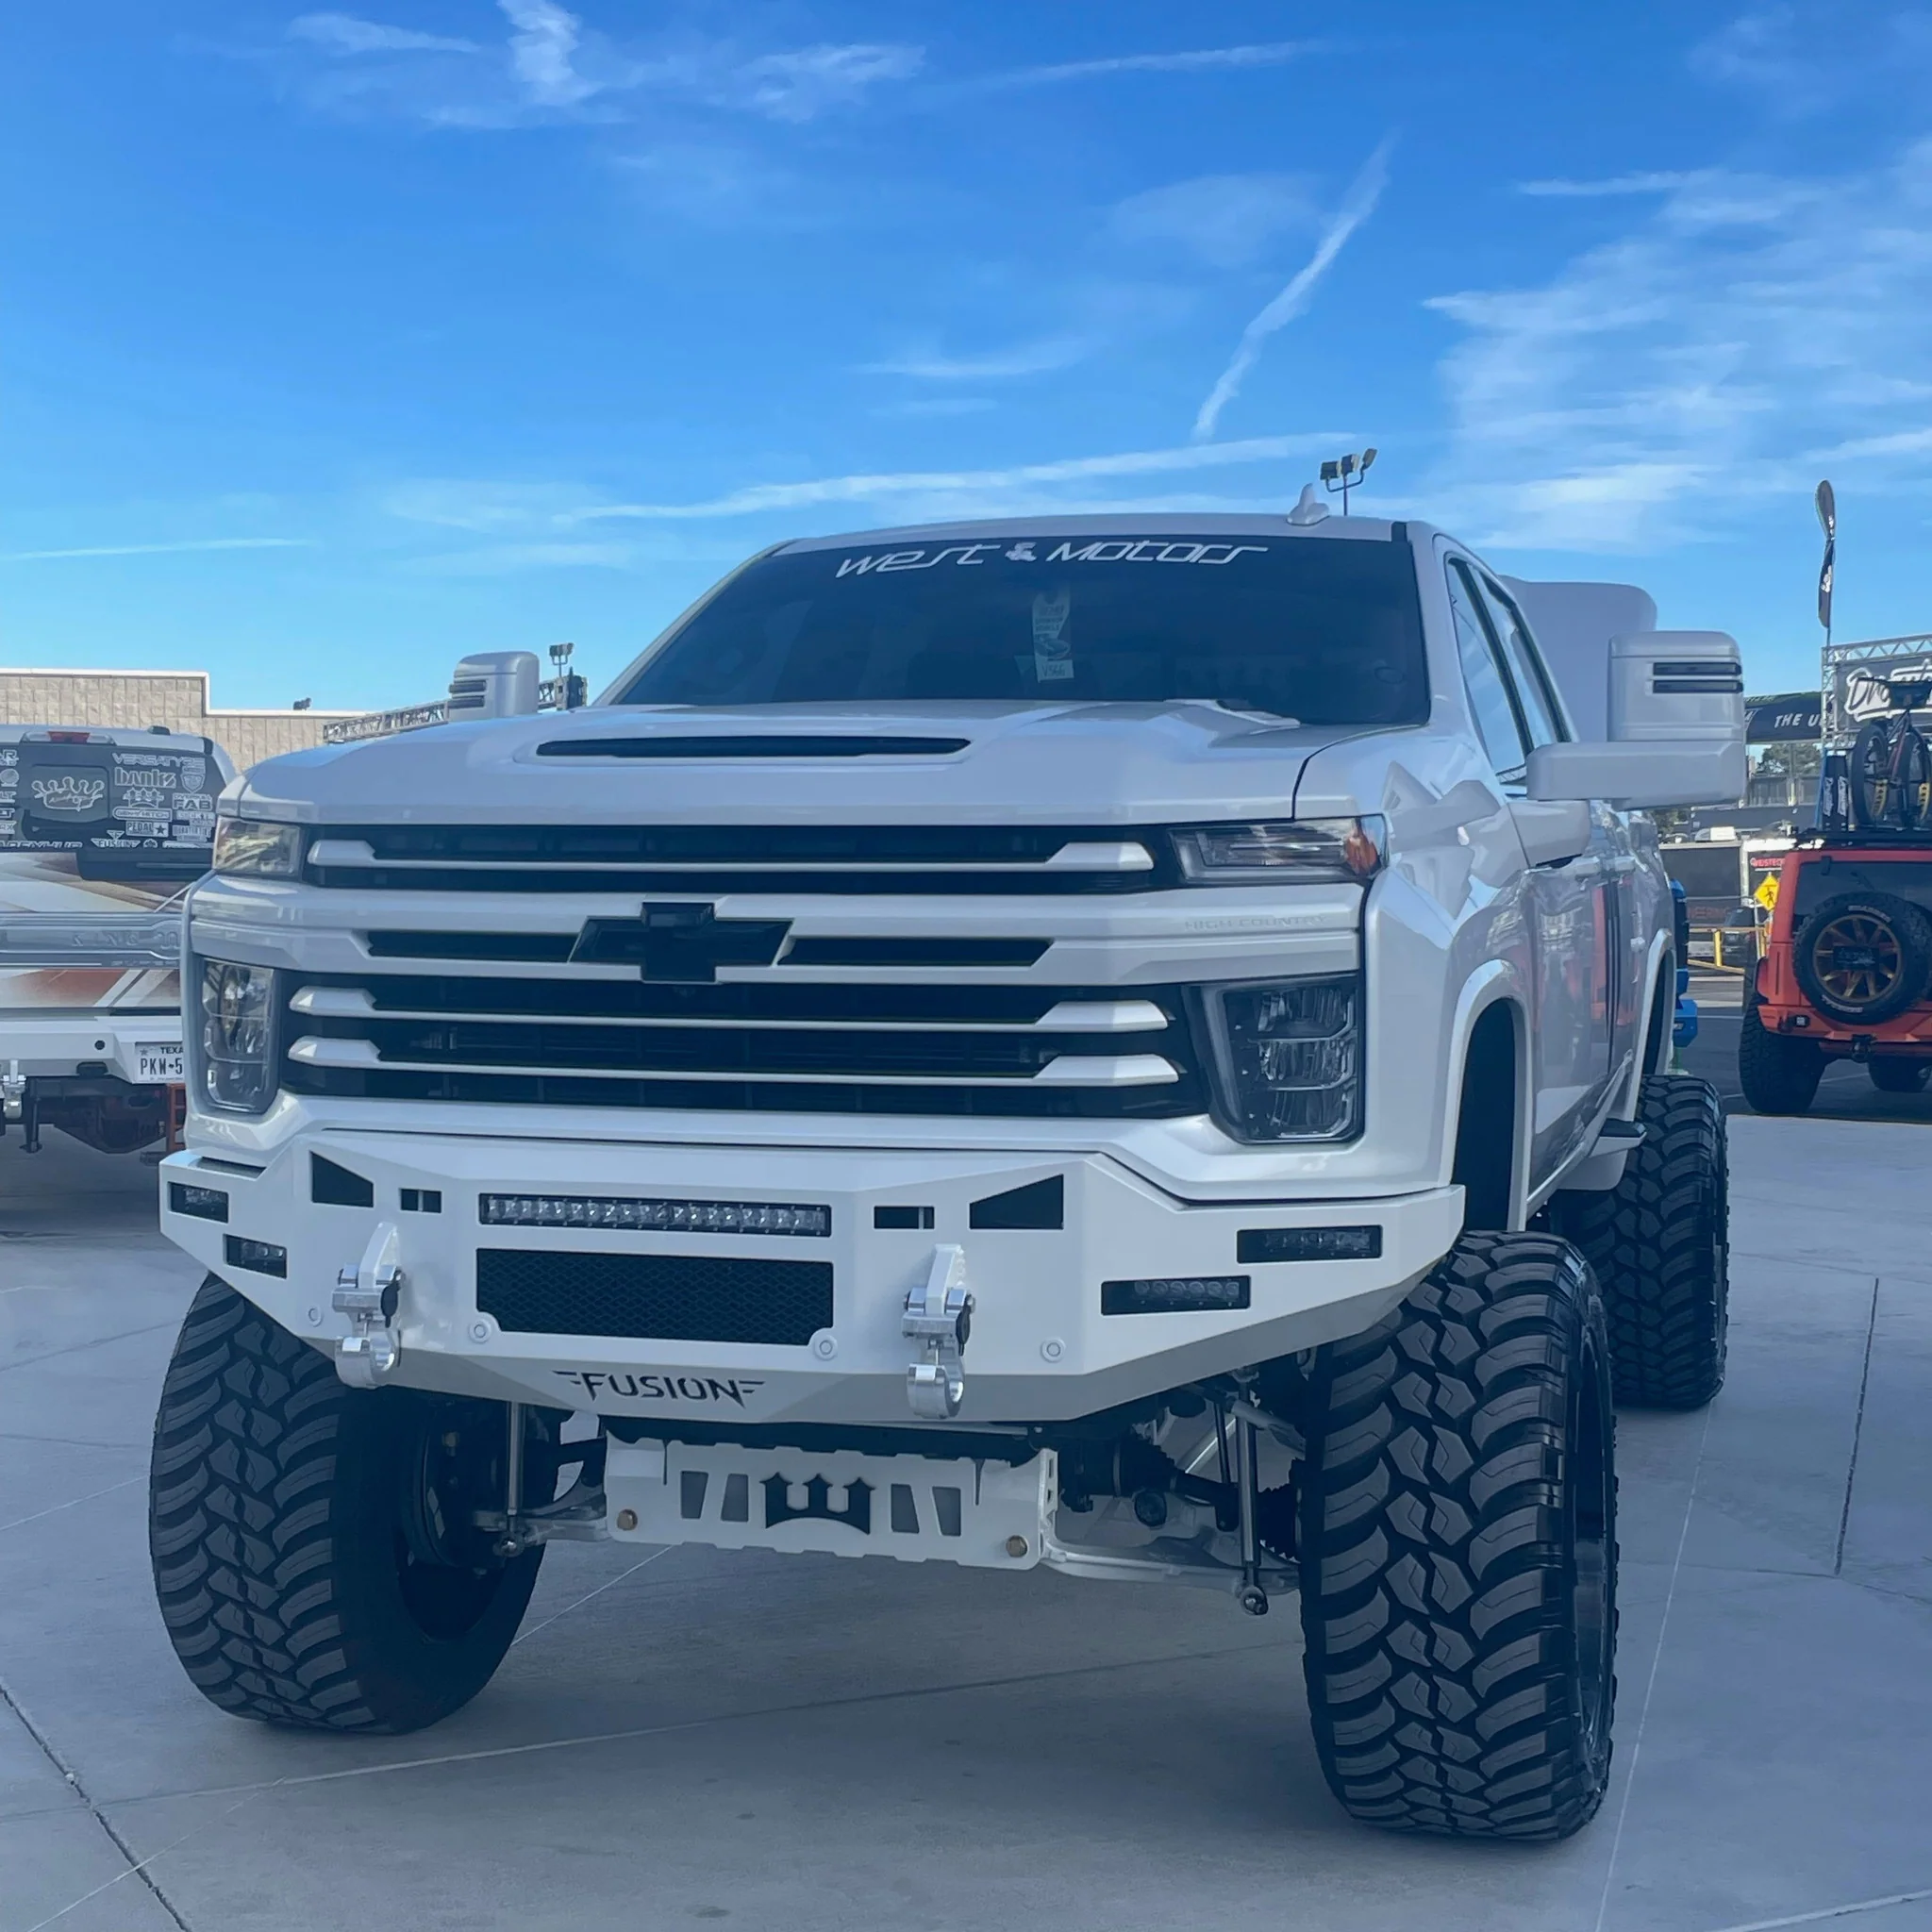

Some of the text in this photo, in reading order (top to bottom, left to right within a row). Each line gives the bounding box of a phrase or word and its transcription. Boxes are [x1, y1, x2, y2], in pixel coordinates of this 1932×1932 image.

[1774, 713, 1803, 729] THE
[173, 799, 212, 809] FAB
[1184, 915, 1327, 931] HIGH COUNTRY
[577, 1371, 747, 1409] FUSION
